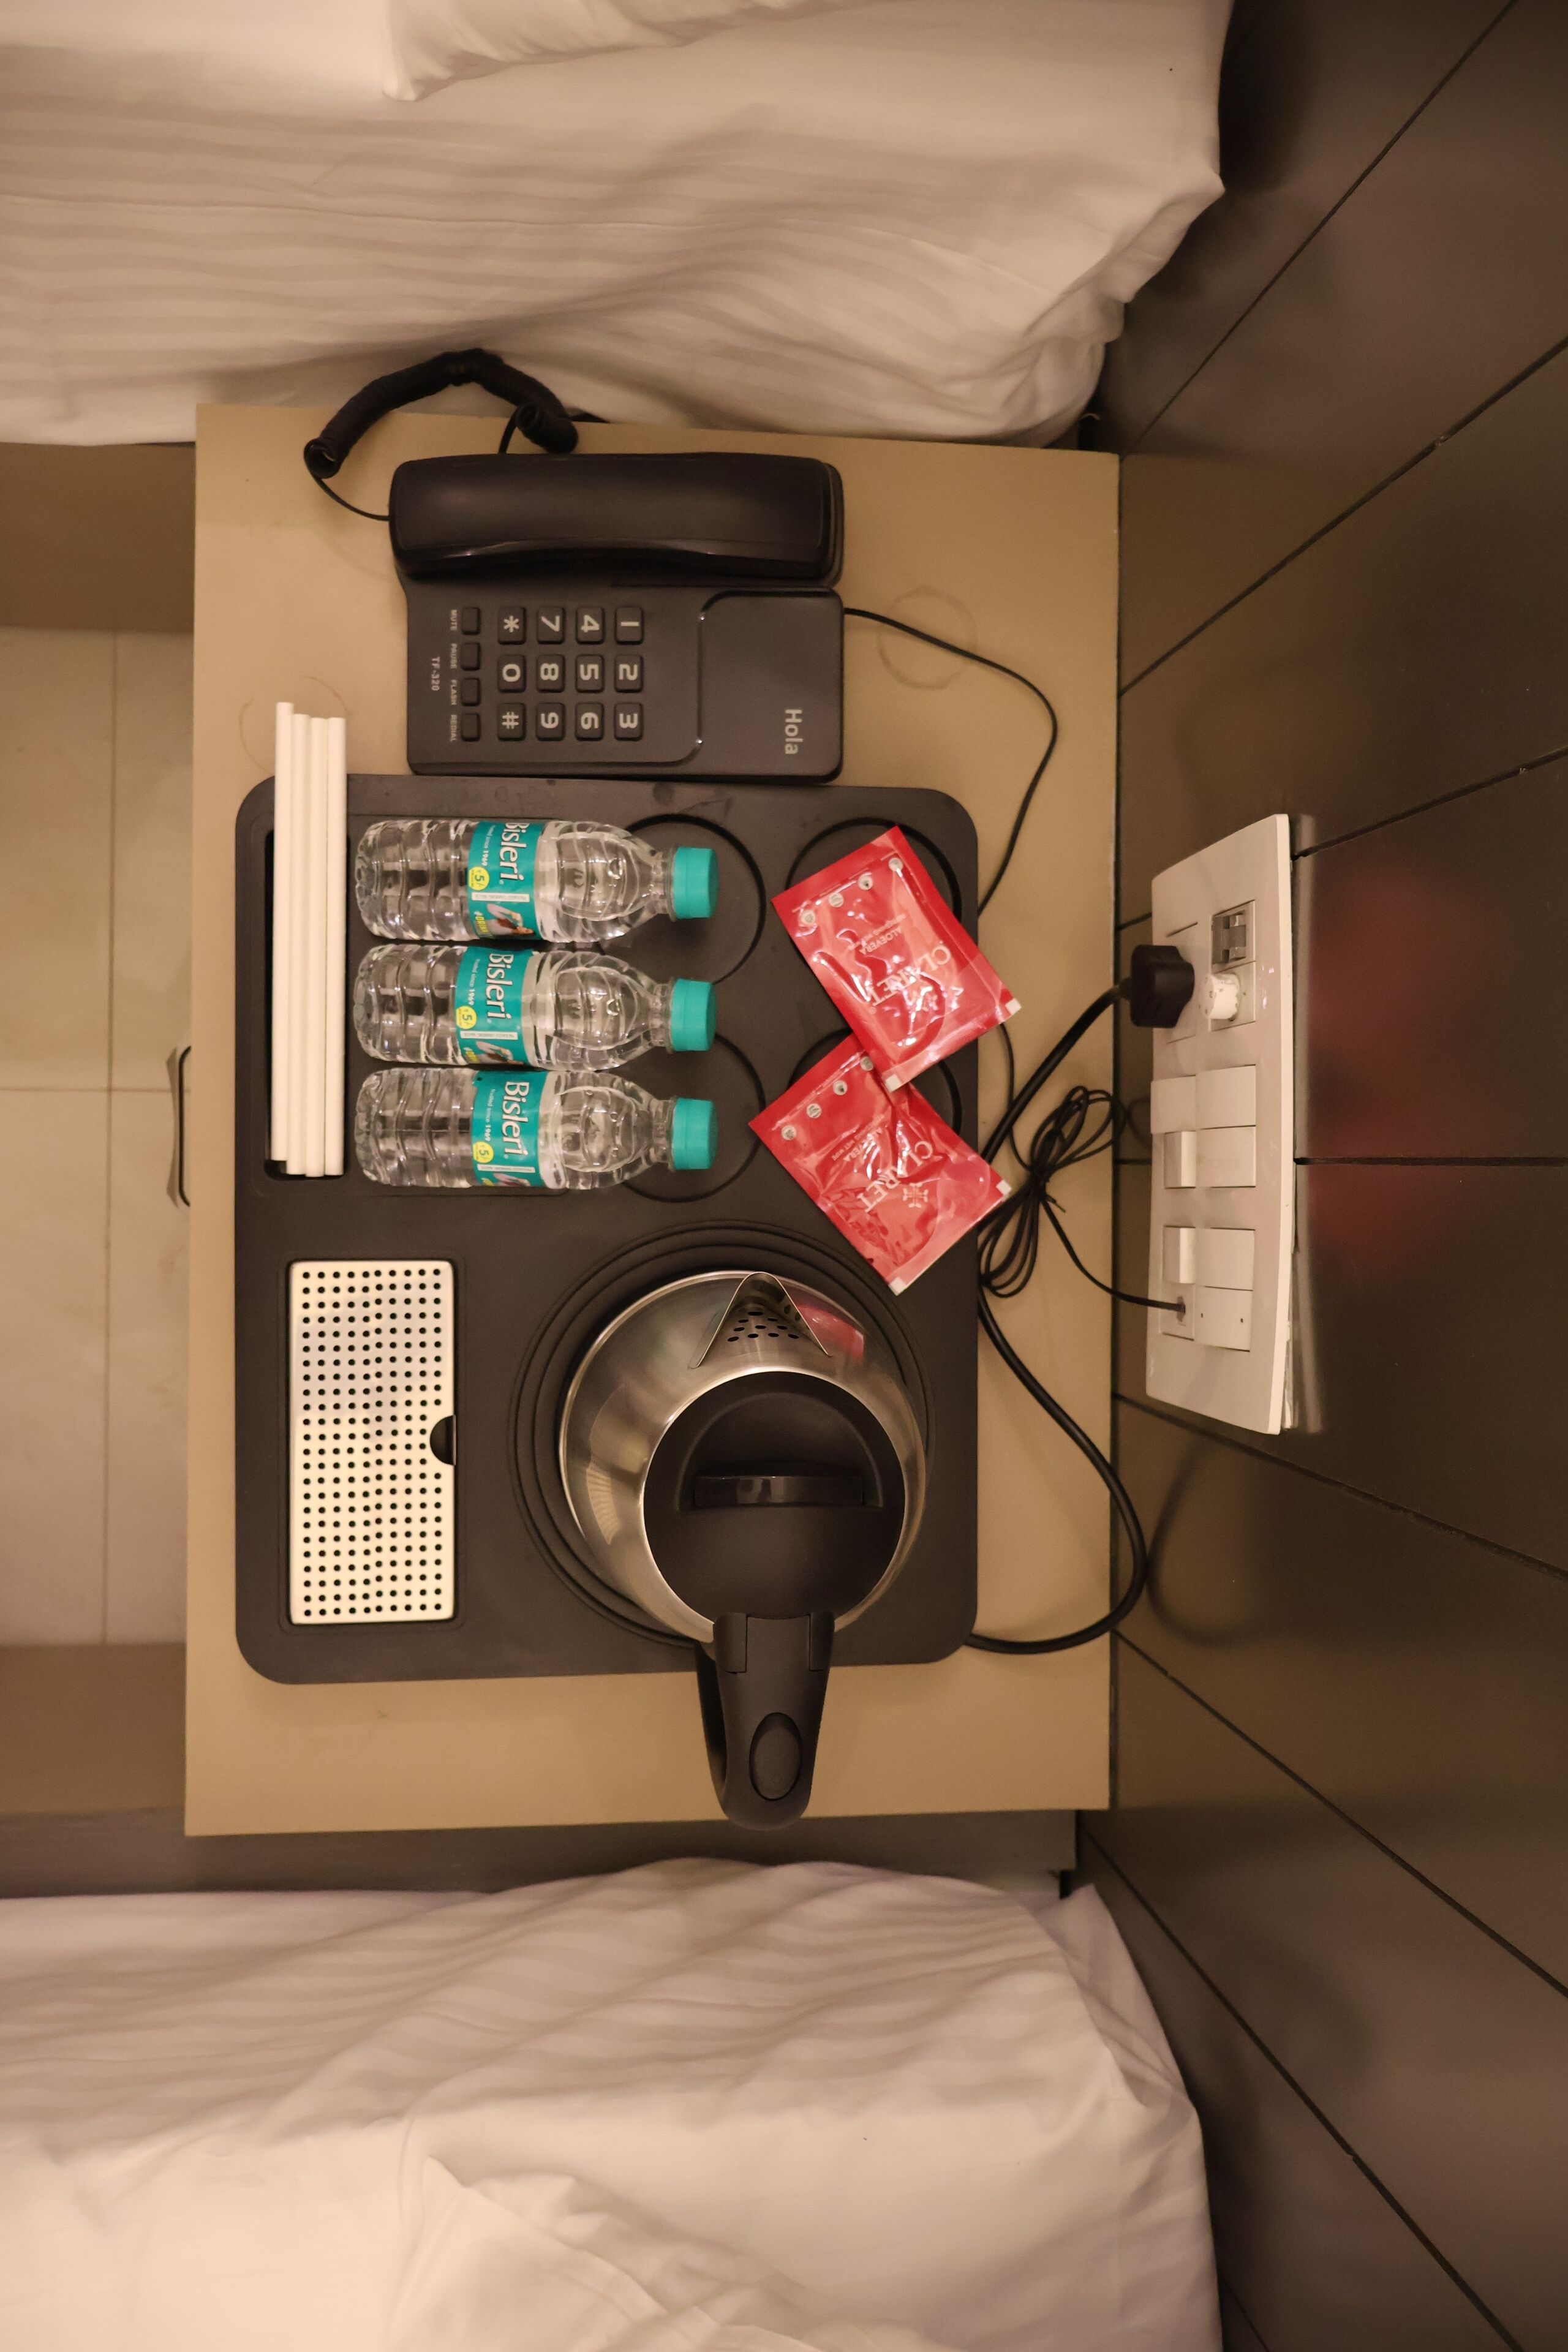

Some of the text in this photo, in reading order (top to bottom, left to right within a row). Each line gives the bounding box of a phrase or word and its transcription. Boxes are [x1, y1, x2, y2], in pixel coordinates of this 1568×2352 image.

[503, 664, 520, 682] 0
[541, 616, 559, 728] 7 8 9
[580, 615, 599, 729] 4 5 6
[619, 664, 638, 680] 2
[502, 712, 519, 729] #
[620, 714, 638, 728] 3
[785, 710, 802, 754] Hola
[499, 823, 530, 881] Bisleri
[486, 953, 514, 1019] Bisleri
[867, 944, 951, 1006] CLARET
[487, 1089, 496, 1107] trusted
[502, 1082, 529, 1155] Bisleri
[857, 1140, 933, 1213] CLARET
